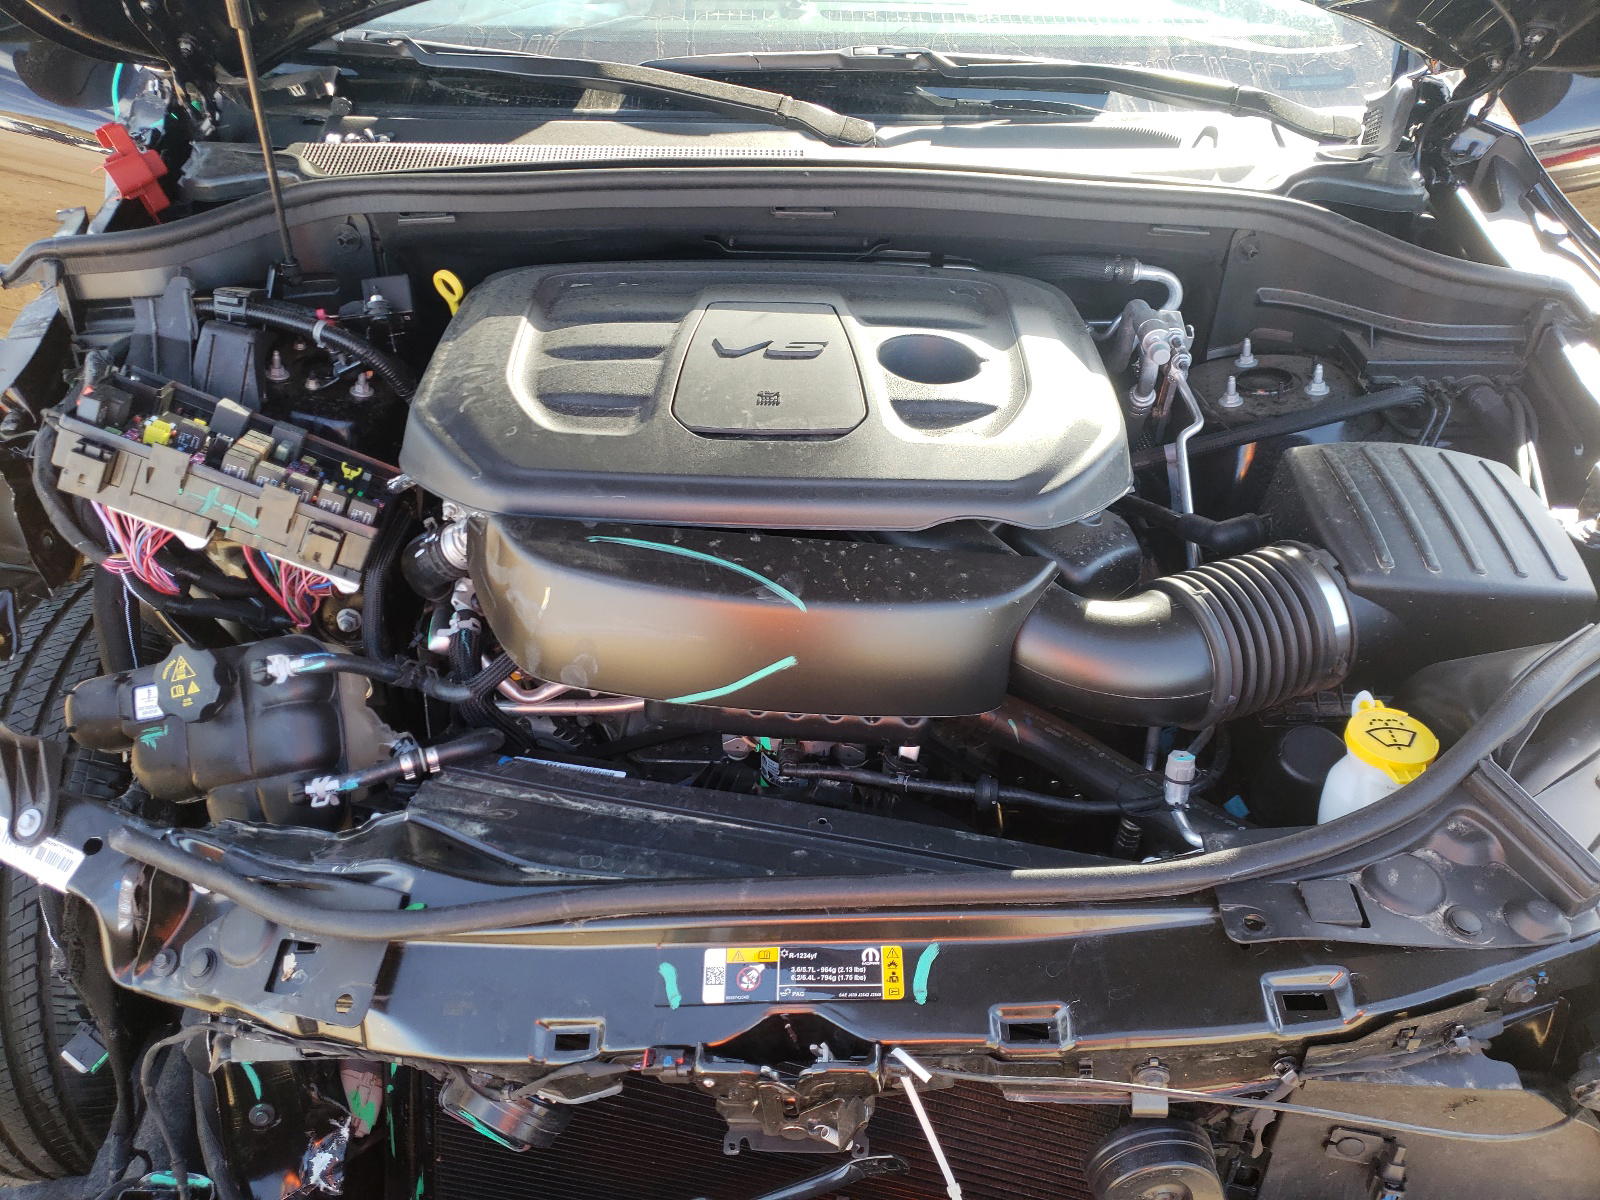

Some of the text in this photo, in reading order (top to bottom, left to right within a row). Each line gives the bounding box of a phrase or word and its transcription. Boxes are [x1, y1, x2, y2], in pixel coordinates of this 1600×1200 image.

[788, 952, 818, 960] R-1234yf
[837, 966, 853, 974] (2.13
[853, 966, 867, 974] lbs)
[853, 974, 867, 982] lbs)
